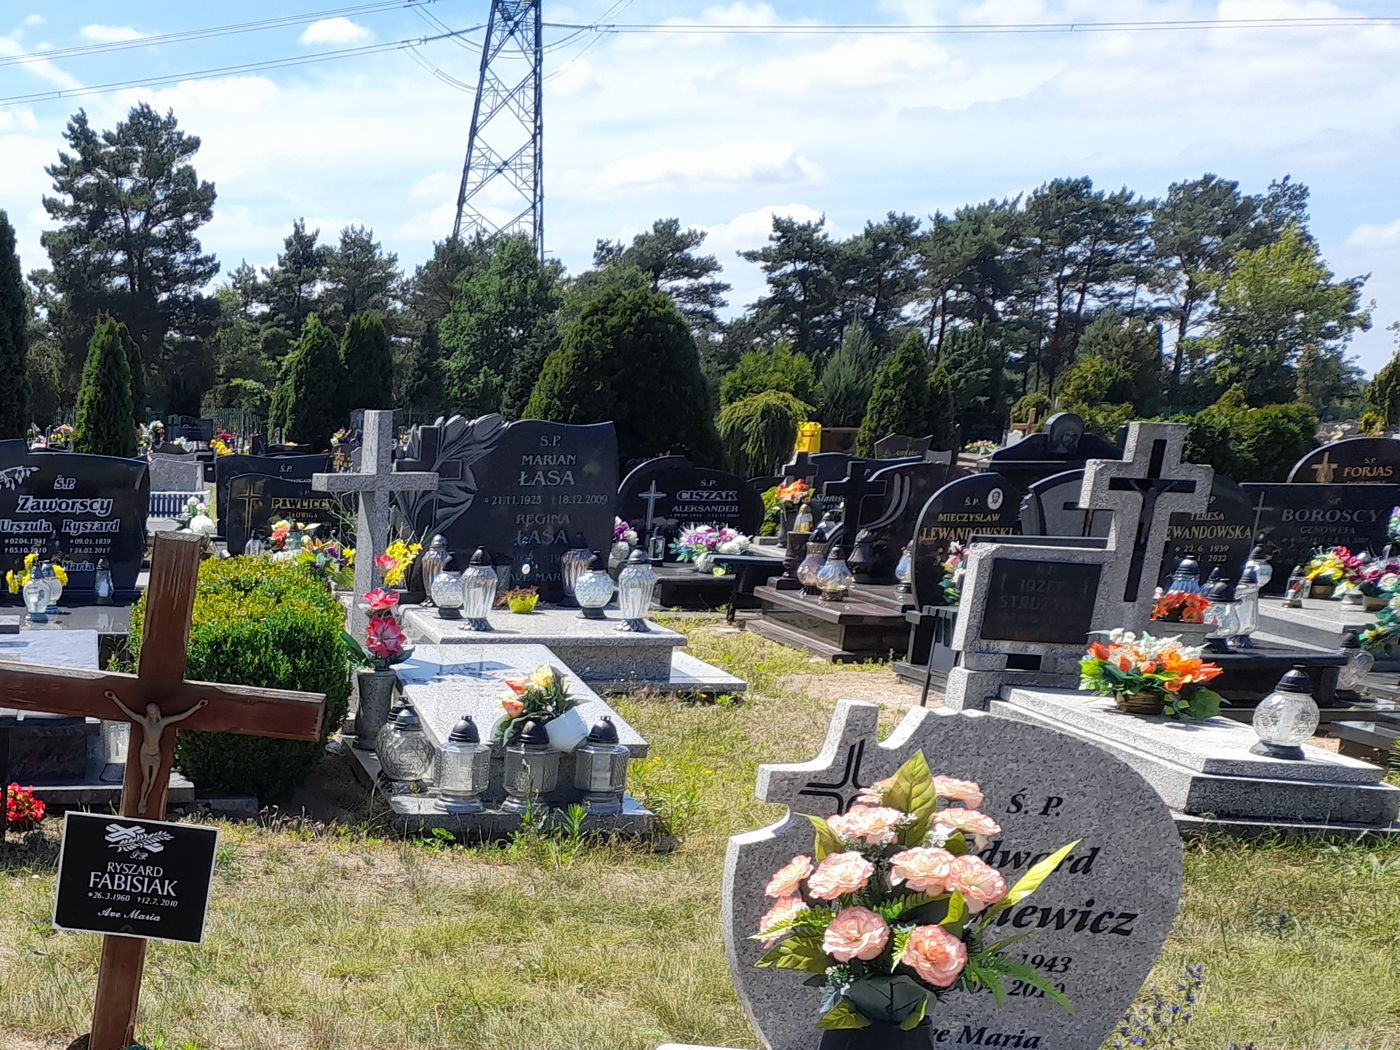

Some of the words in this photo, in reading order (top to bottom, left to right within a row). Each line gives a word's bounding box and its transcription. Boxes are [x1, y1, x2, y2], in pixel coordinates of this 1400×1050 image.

[520, 454, 577, 466] MARIAN
[518, 470, 576, 486] ŁASA
[1343, 465, 1394, 478] FORJAS
[676, 489, 738, 501] CISZAK
[15, 494, 114, 517] Zaworscy
[671, 504, 739, 513] ALEKSANDER
[516, 513, 571, 525] REGINA
[1189, 511, 1225, 521] TERESA
[1281, 508, 1384, 523] BOROSCY
[61, 518, 120, 536] Ryszard
[920, 526, 1015, 541] LEWANDOWSKI
[1167, 525, 1252, 540] EWANDOWSKA
[107, 862, 163, 877] RYSZARD
[89, 872, 178, 896] FABISIAK
[97, 906, 122, 918] Ave
[123, 908, 162, 922] Maria
[955, 1023, 1042, 1050] Maria
